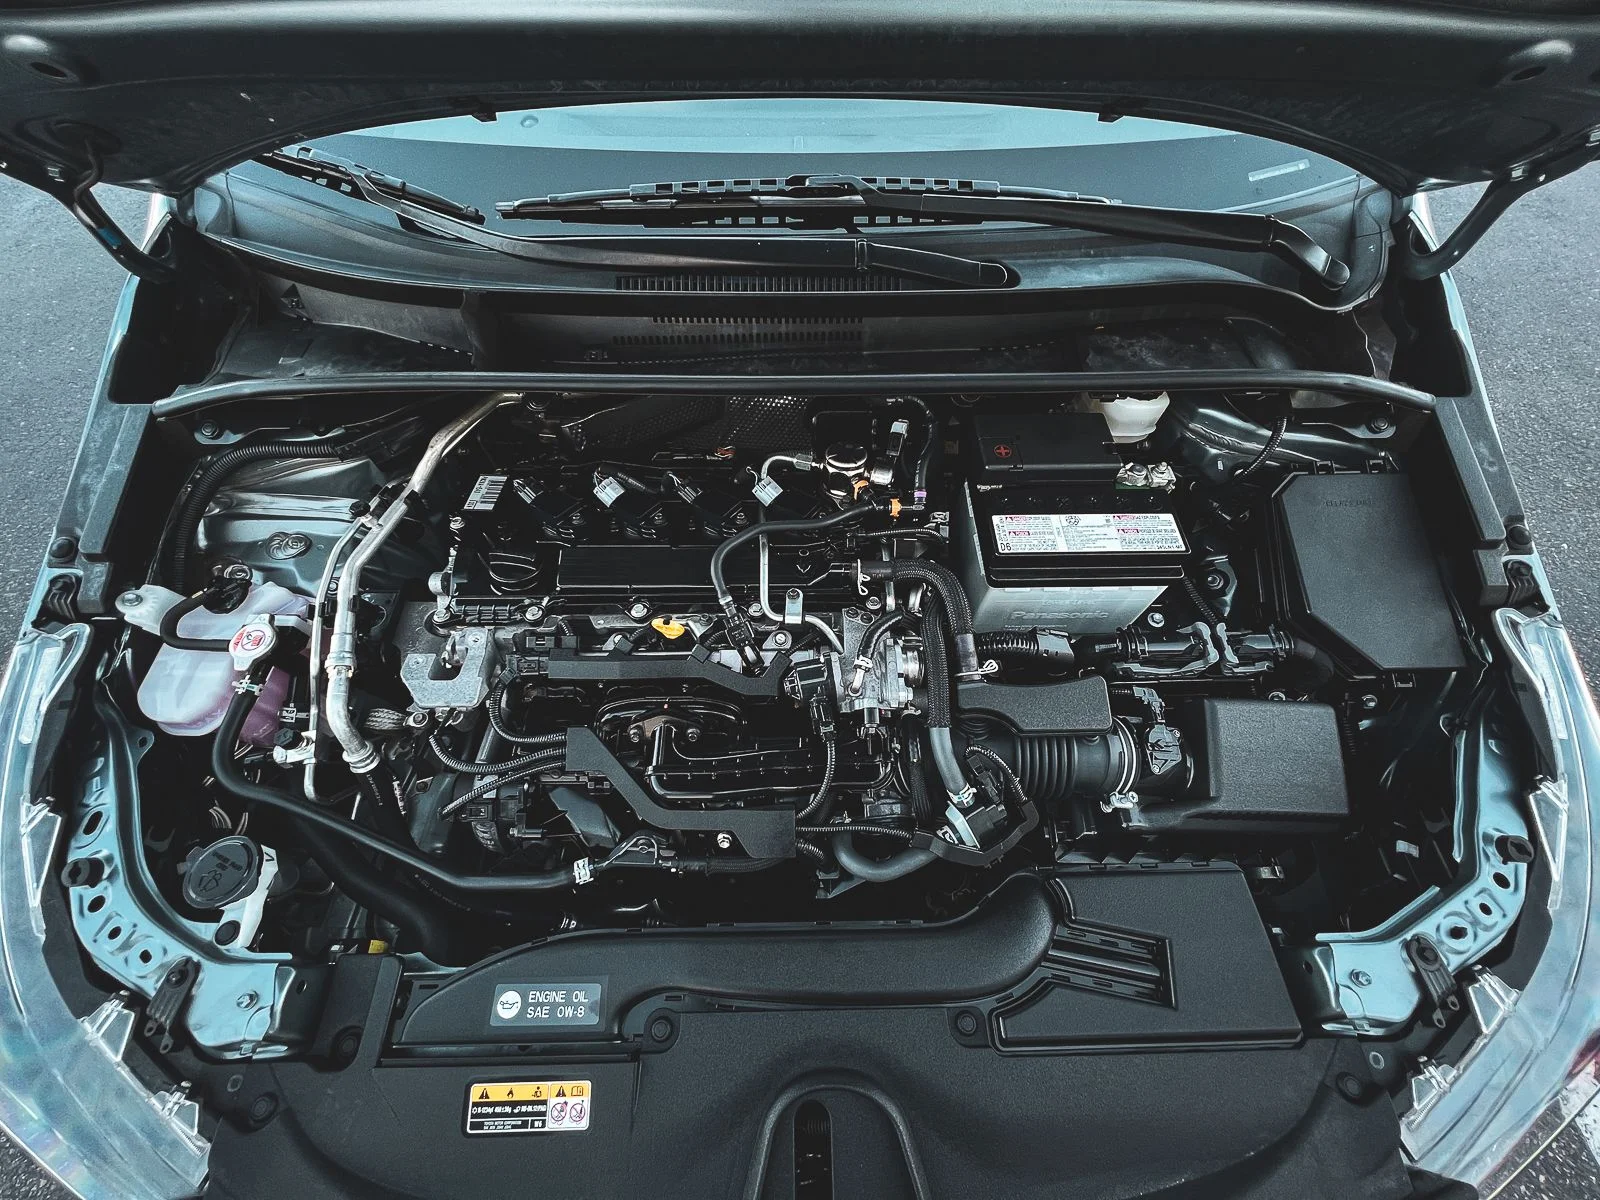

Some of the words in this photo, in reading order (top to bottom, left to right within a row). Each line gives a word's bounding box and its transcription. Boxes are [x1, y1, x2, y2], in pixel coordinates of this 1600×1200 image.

[1010, 610, 1109, 620] Panasonic
[528, 990, 567, 1003] ENGINE
[572, 990, 589, 1002] OIL
[526, 1006, 551, 1018] SAE
[557, 1005, 585, 1018] 0W-8
